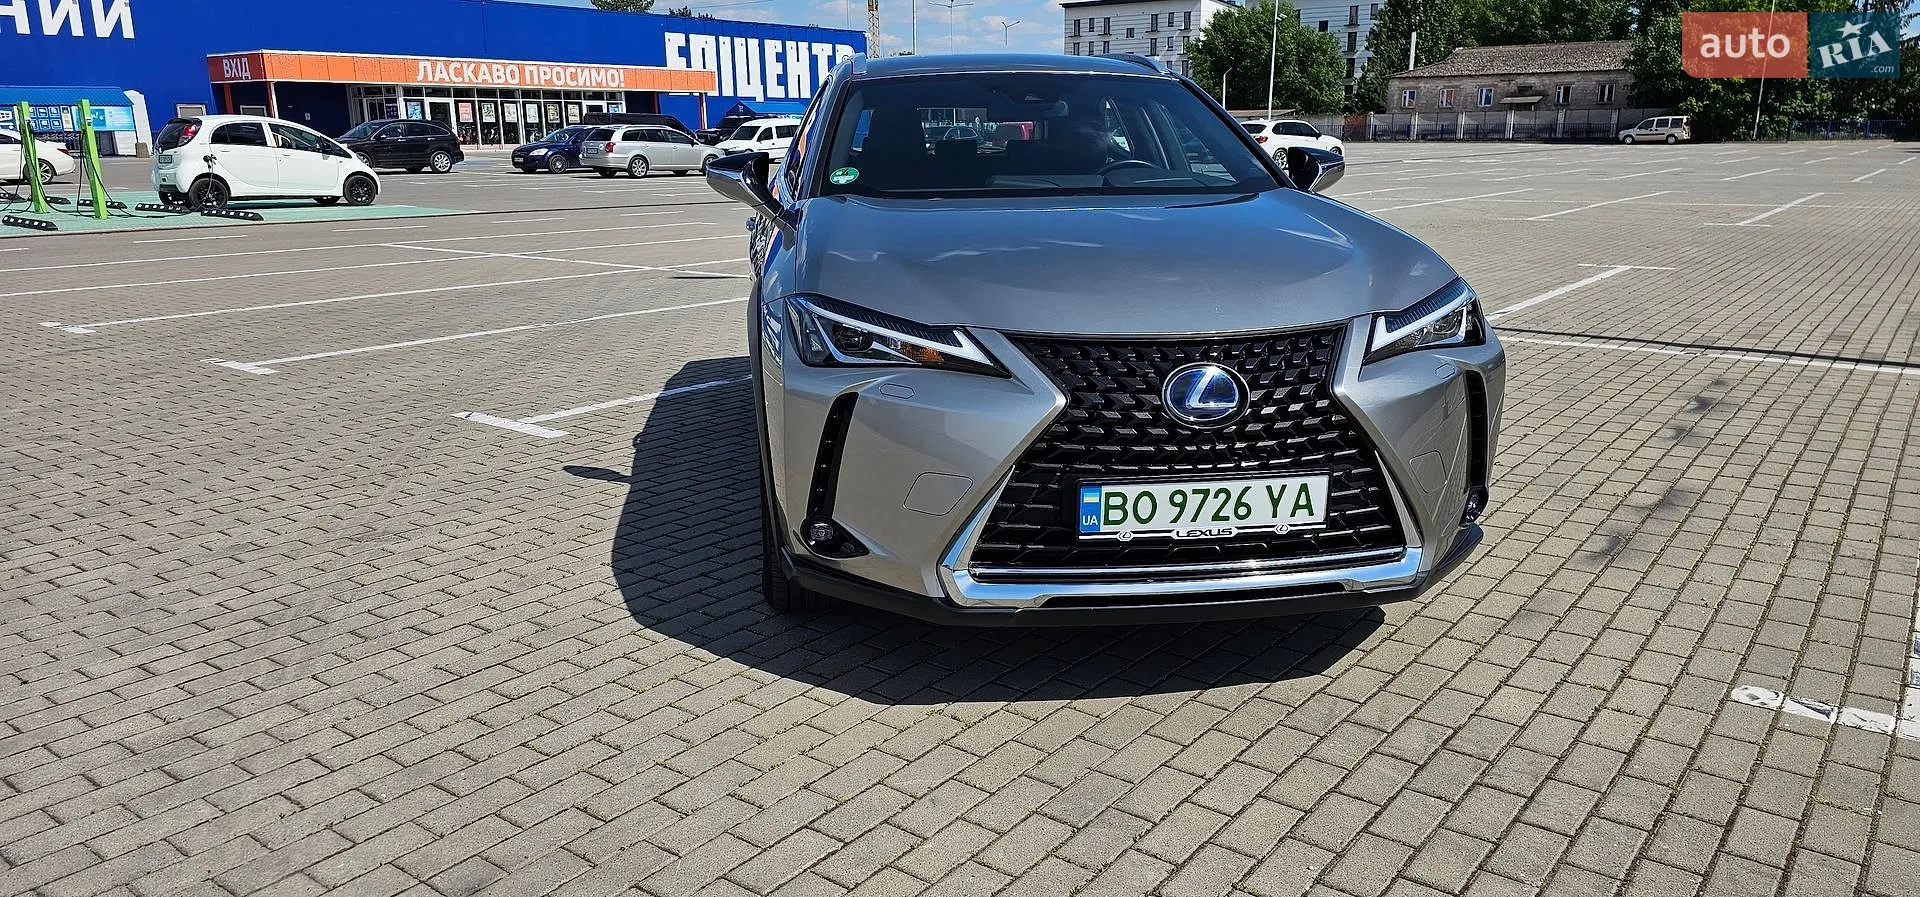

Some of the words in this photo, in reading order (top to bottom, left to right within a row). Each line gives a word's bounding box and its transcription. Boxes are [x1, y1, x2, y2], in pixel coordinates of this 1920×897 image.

[222, 57, 251, 80] ВХІД
[416, 60, 520, 85] ЛАСКАВО
[524, 65, 625, 88] ПРОСИМО!
[1103, 491, 1158, 525] BO
[1168, 485, 1253, 524] 9726
[1265, 482, 1315, 518] YA
[1082, 515, 1099, 526] UA
[1175, 527, 1233, 538] LEXUS
